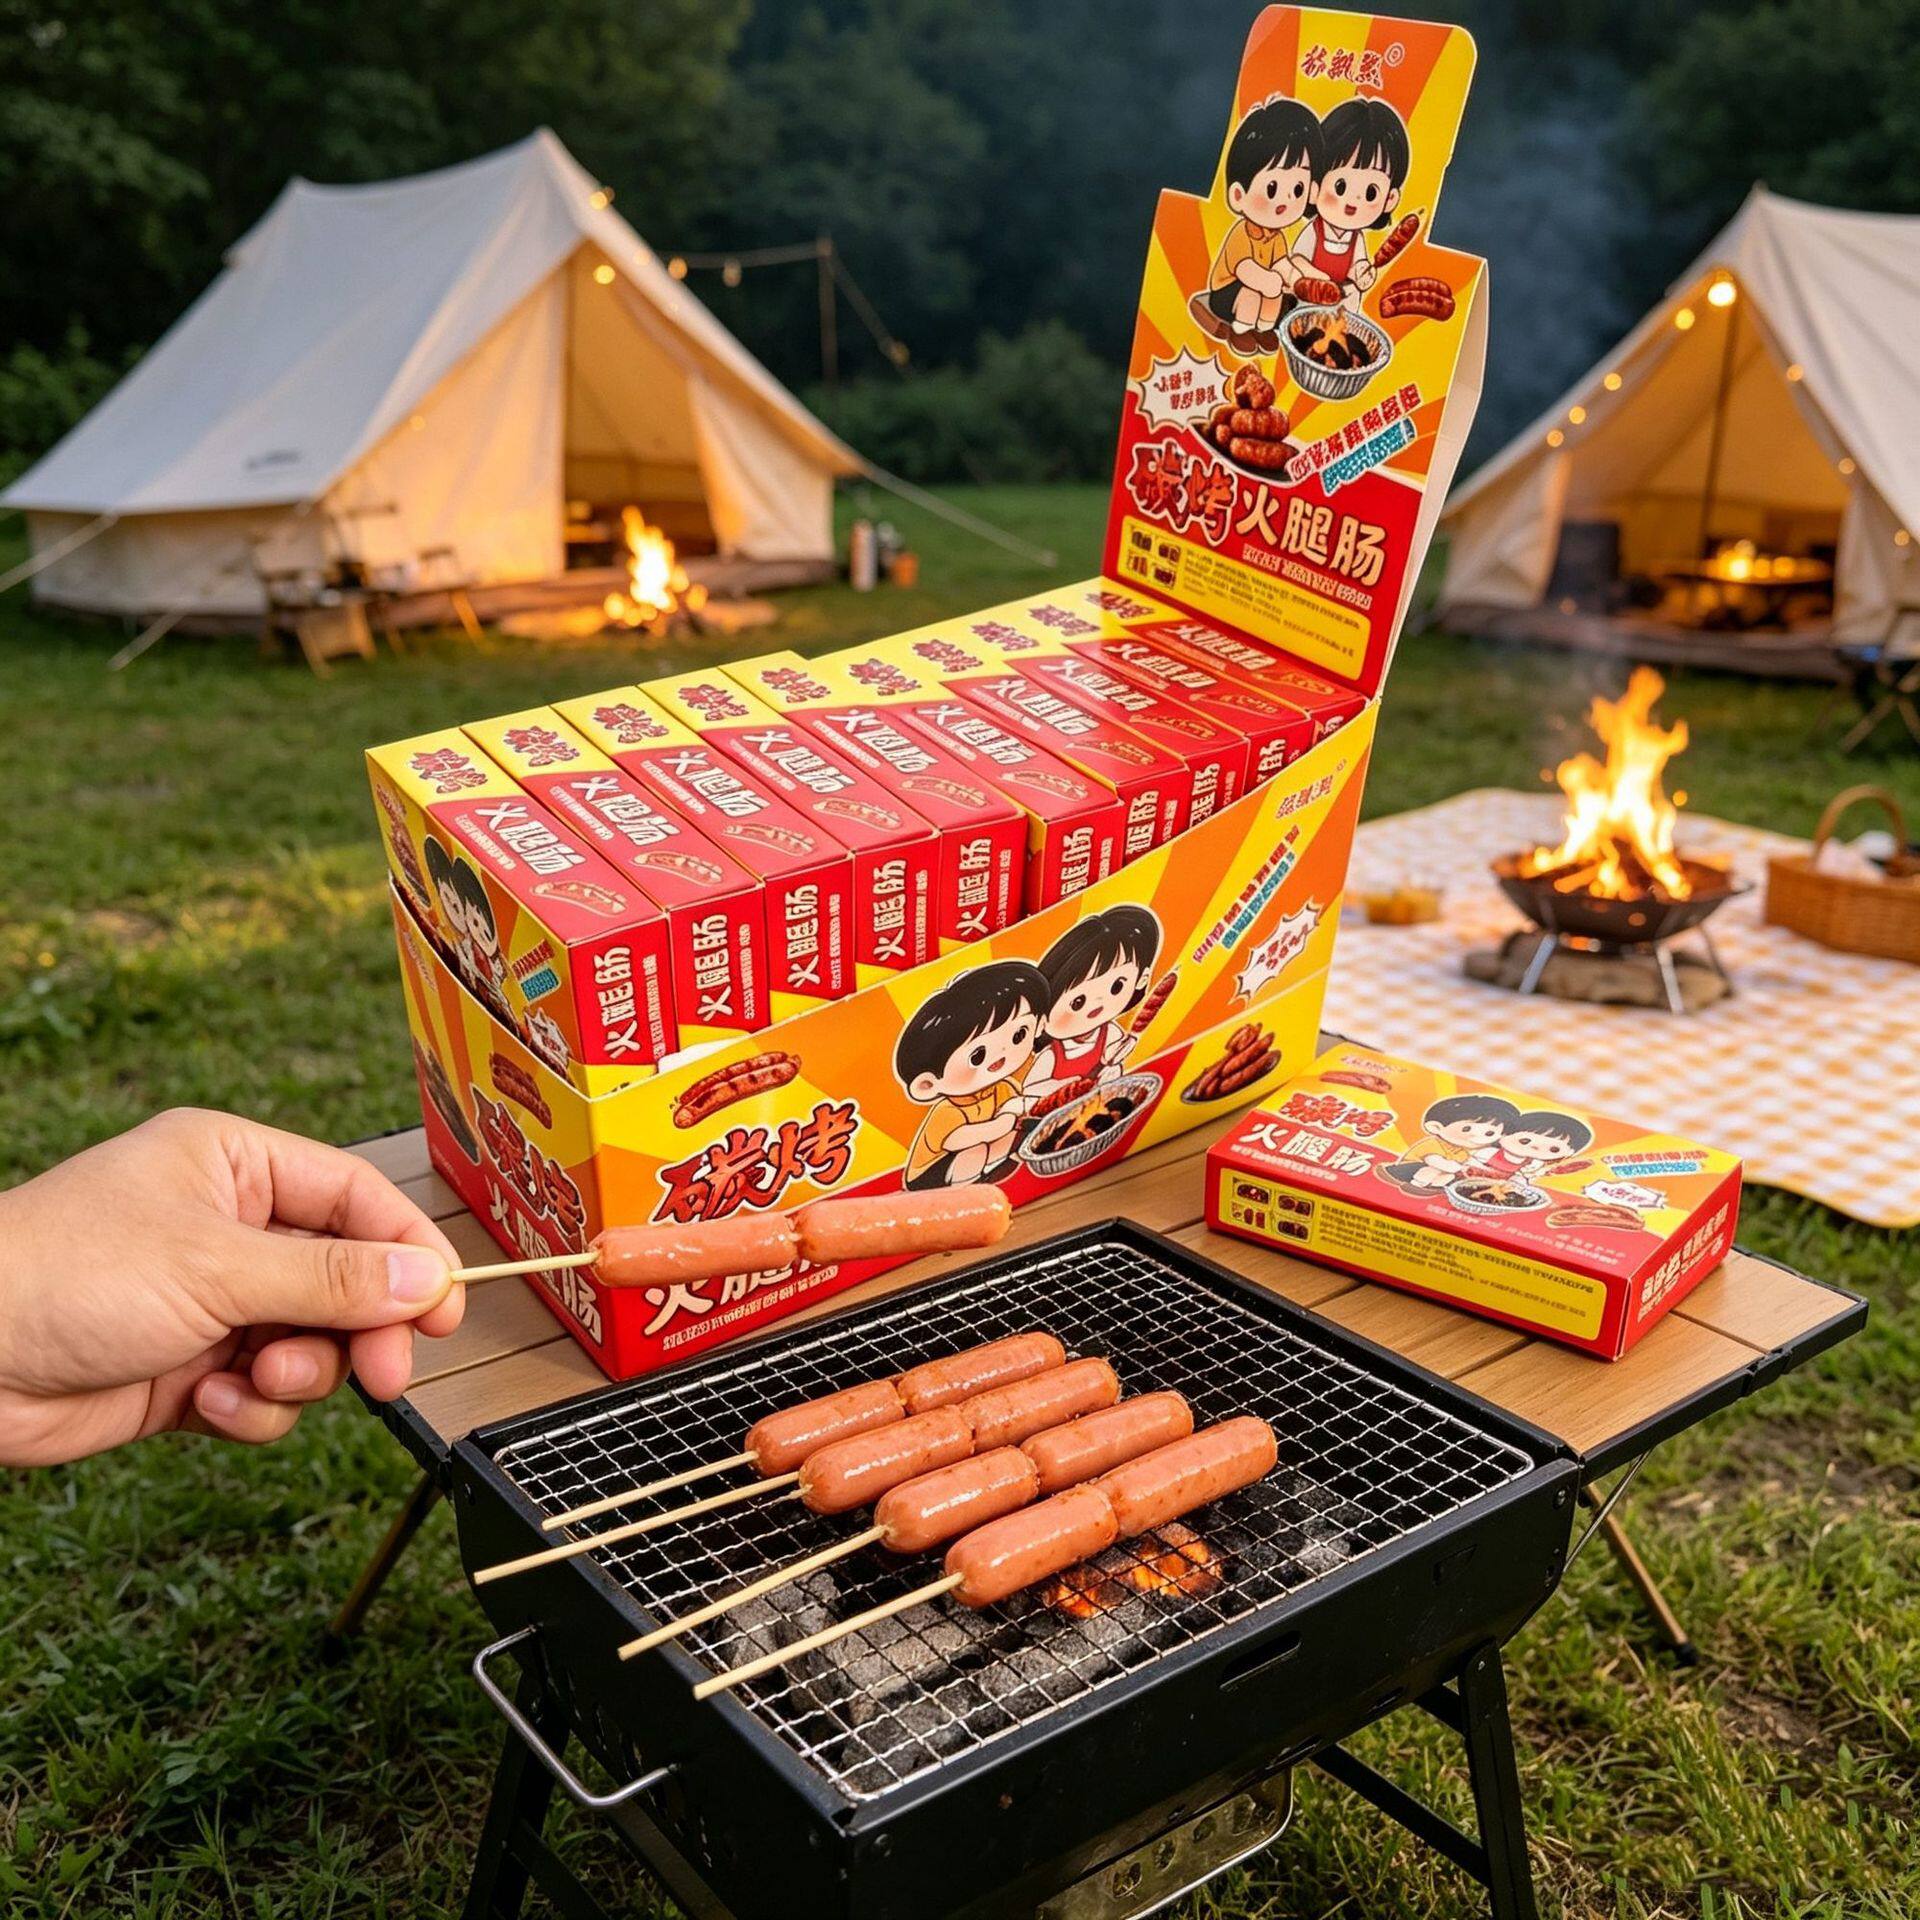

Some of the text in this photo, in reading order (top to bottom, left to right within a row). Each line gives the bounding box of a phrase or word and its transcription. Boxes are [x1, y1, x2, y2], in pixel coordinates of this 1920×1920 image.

[1236, 484, 1386, 587] 火腿肠
[650, 1101, 860, 1224] 碳烤
